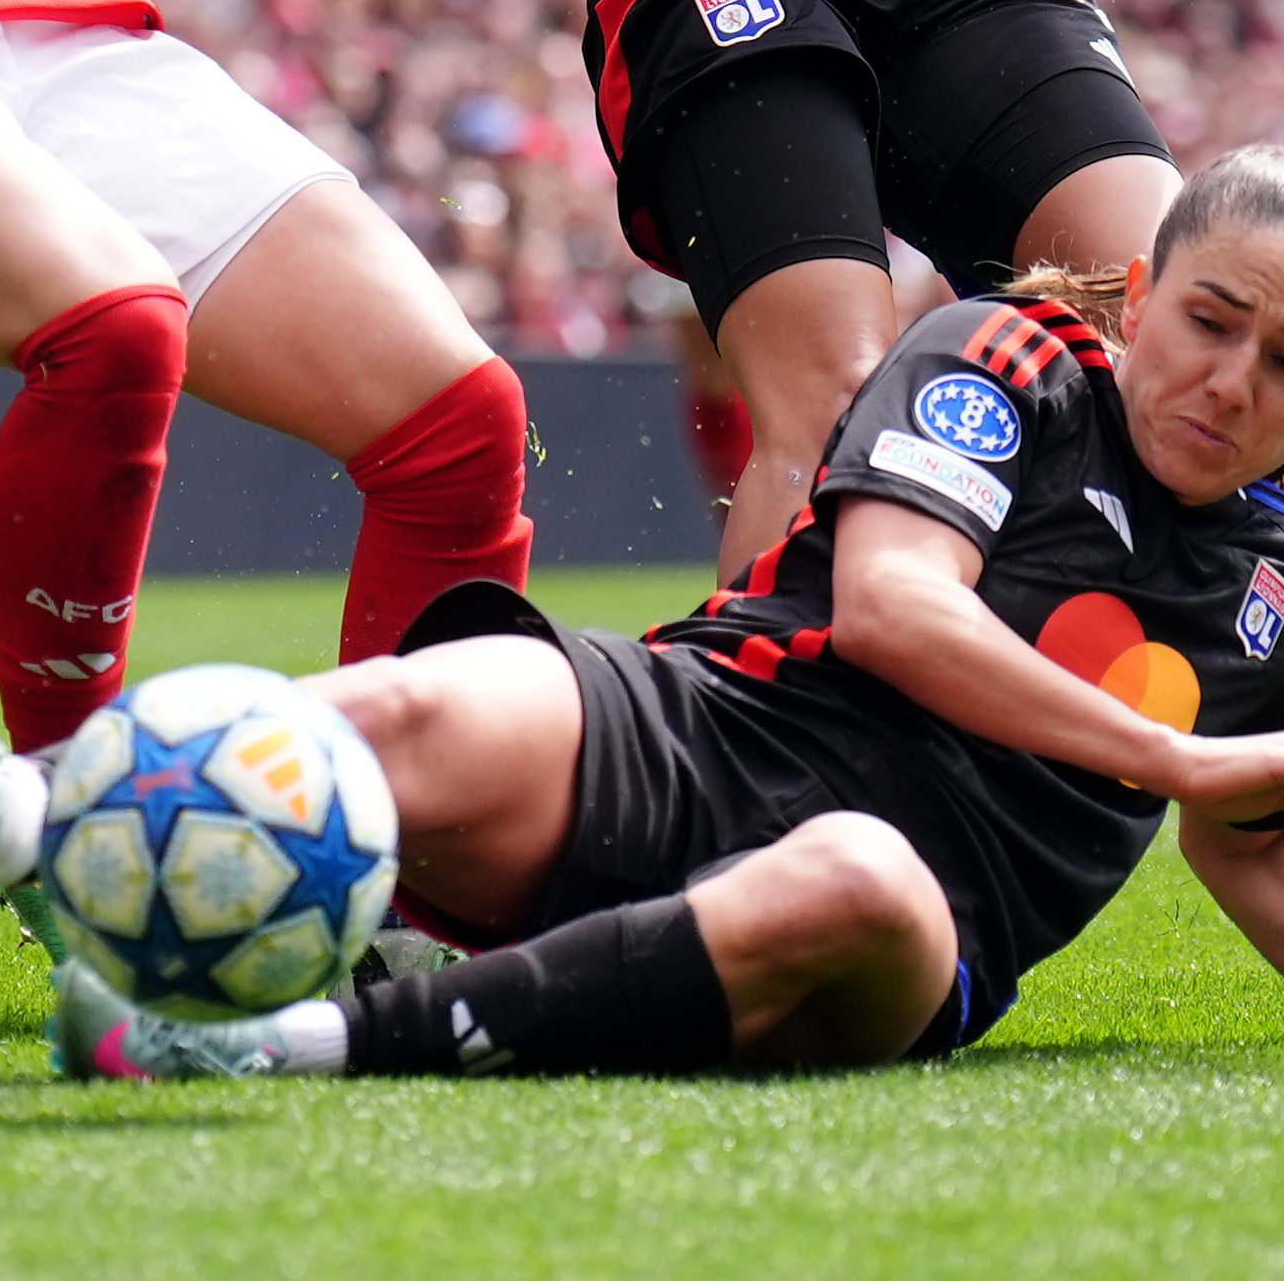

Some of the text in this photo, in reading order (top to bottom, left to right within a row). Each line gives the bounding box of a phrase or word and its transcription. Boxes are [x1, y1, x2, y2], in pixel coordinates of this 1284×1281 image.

[959, 399, 986, 429] 8
[879, 443, 1006, 516] FOUNDATION
[26, 588, 133, 624] AFC
[1245, 599, 1276, 650] OL
